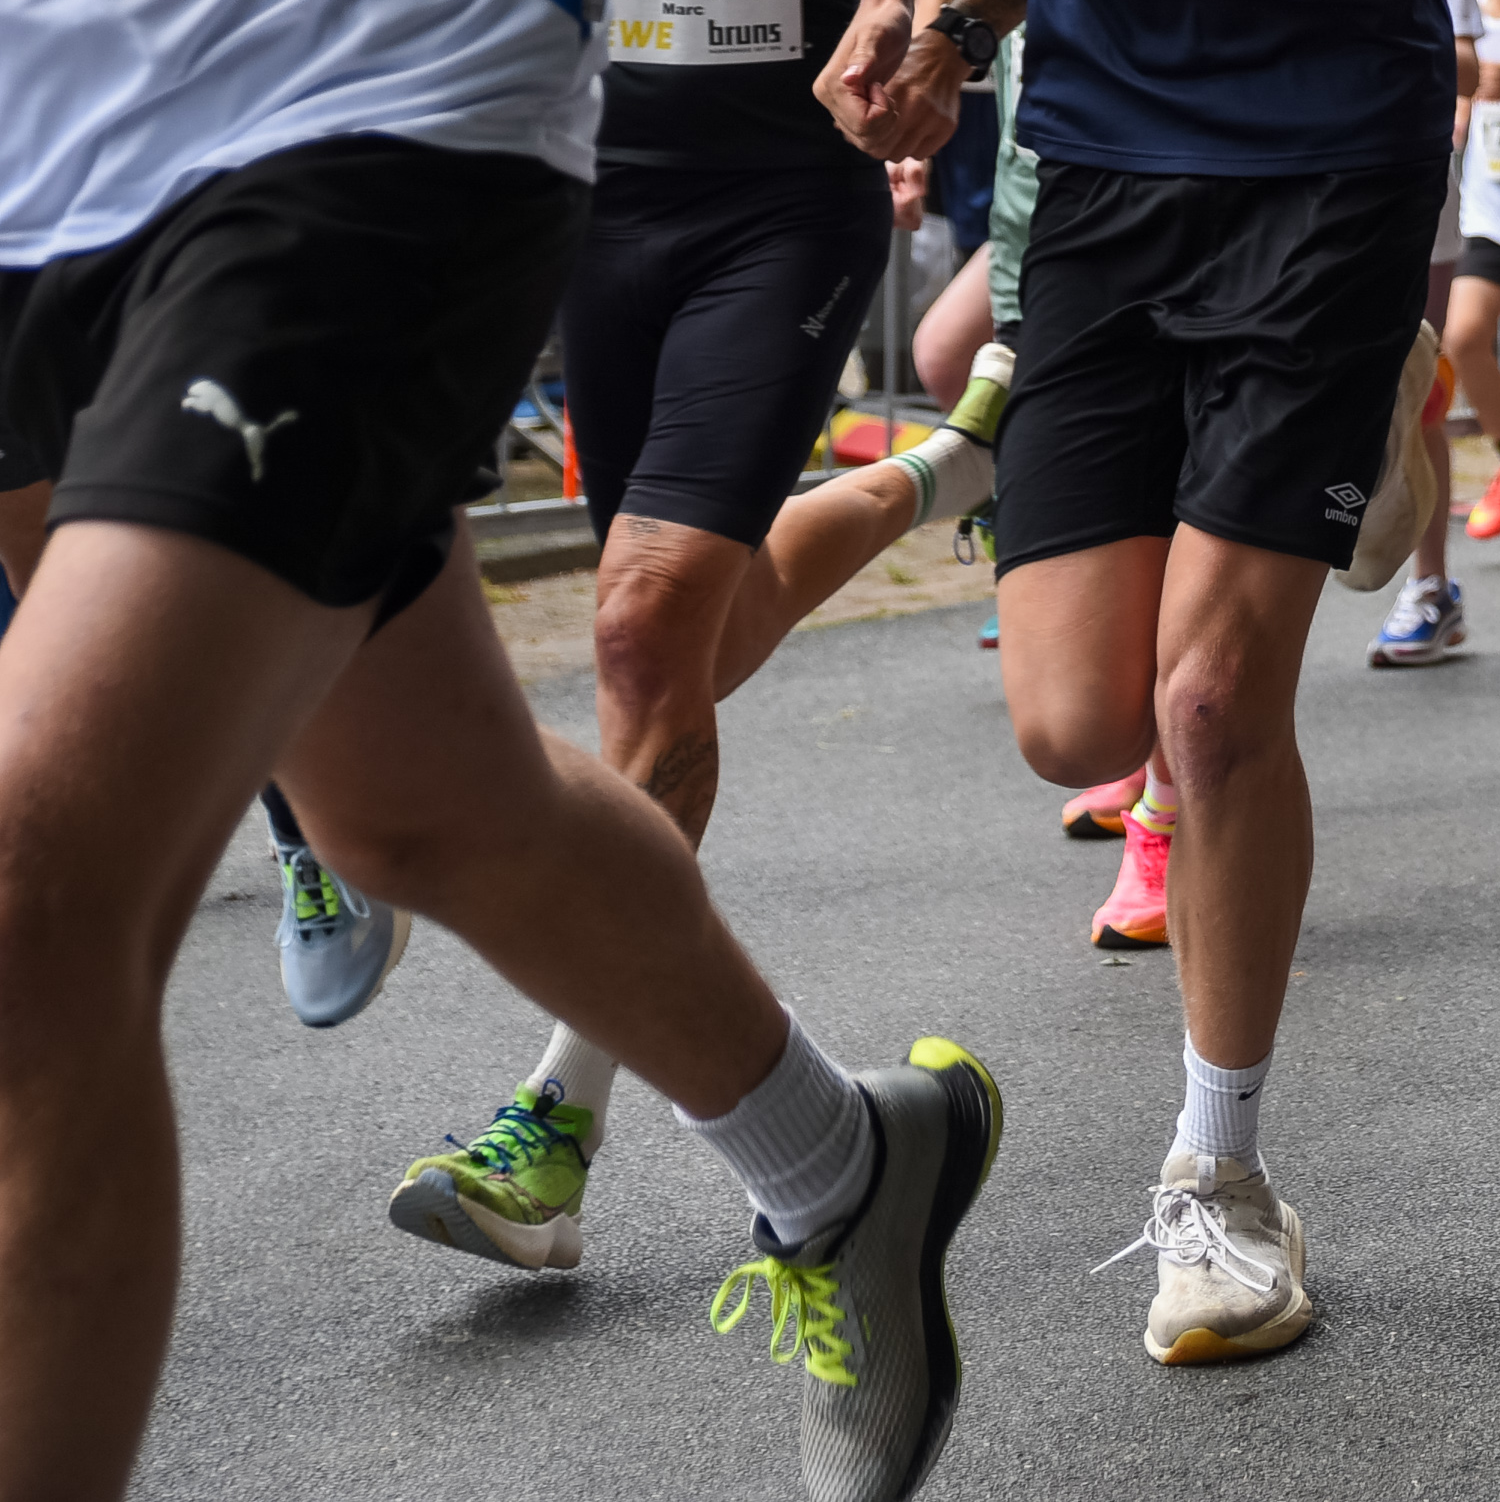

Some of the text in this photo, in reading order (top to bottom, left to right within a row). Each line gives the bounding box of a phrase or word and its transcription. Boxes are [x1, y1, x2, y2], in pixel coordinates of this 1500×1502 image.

[662, 3, 705, 15] Marc
[708, 19, 782, 46] bruns
[1325, 508, 1358, 526] umbro
